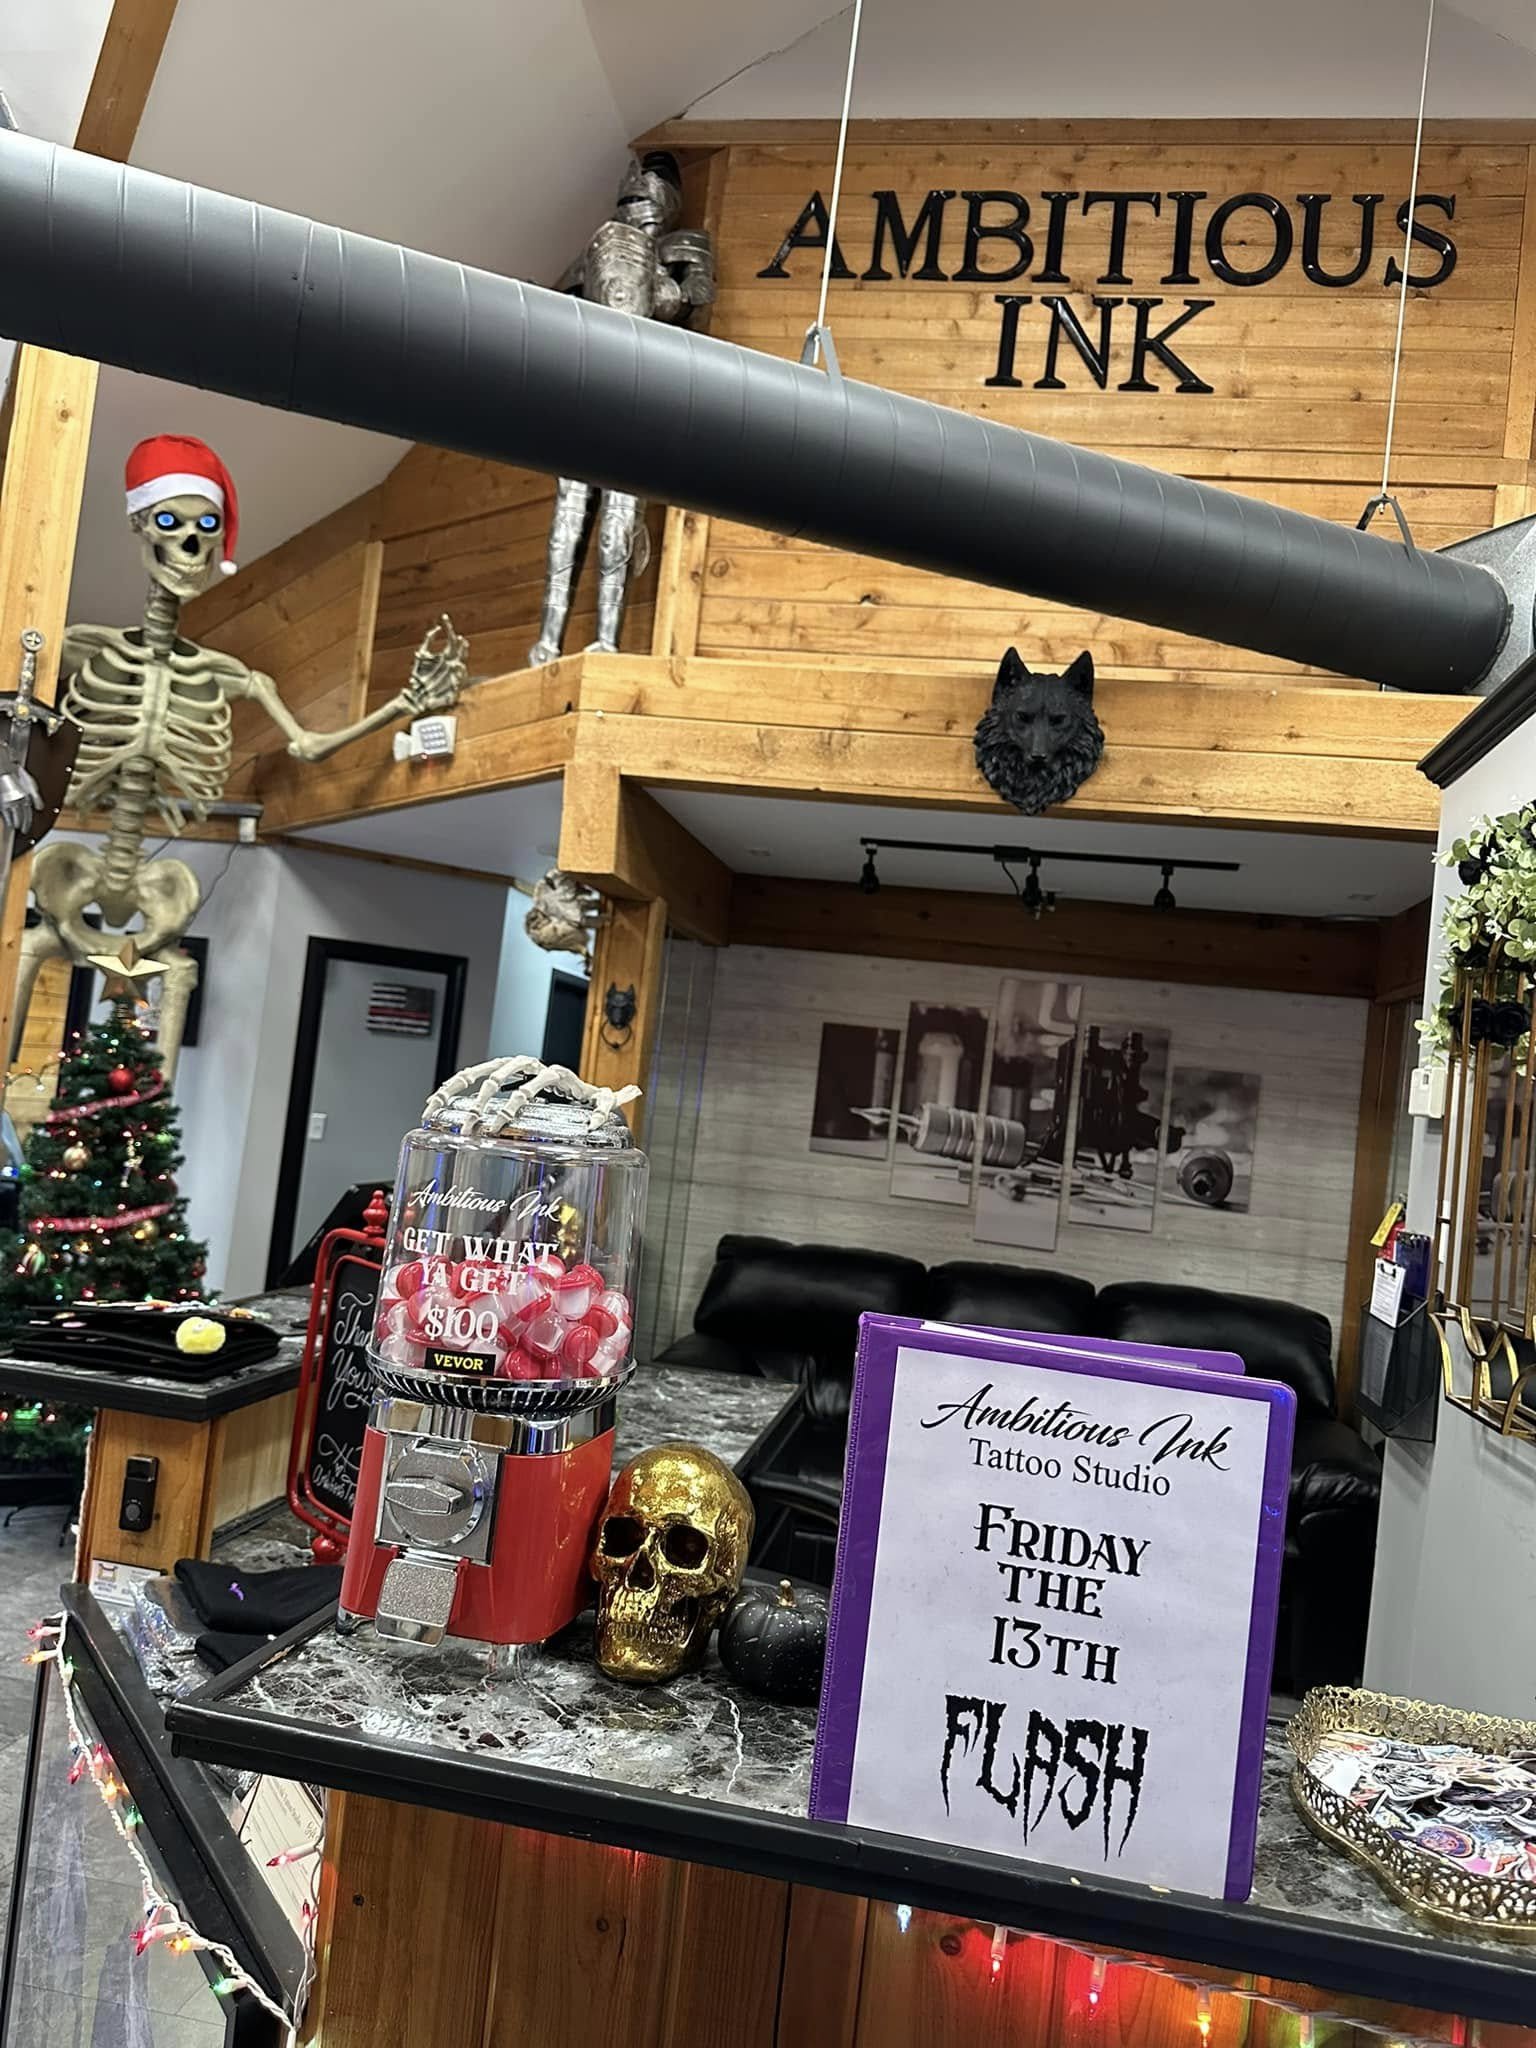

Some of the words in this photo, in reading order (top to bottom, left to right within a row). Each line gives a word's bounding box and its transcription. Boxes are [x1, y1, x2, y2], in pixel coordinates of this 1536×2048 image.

[757, 190, 1457, 288] AMBITIOUS
[985, 295, 1215, 393] INK
[408, 1180, 507, 1214] Ambitious
[510, 1191, 562, 1222] Ink
[403, 1227, 452, 1256] GET
[462, 1235, 559, 1269] WHAT
[421, 1259, 450, 1288] YA
[459, 1268, 527, 1297] GET
[424, 1305, 499, 1342] $100
[434, 1353, 484, 1371] VEVOR
[920, 1383, 1135, 1448] Ambitious
[1139, 1412, 1233, 1470] Ink
[968, 1437, 1062, 1479] Tattoo
[1072, 1455, 1171, 1497] Studio
[973, 1503, 1152, 1577] FRIDAY
[997, 1562, 1107, 1619] THE
[989, 1616, 1121, 1685] 13TH
[940, 1694, 1150, 1862] FLASH
